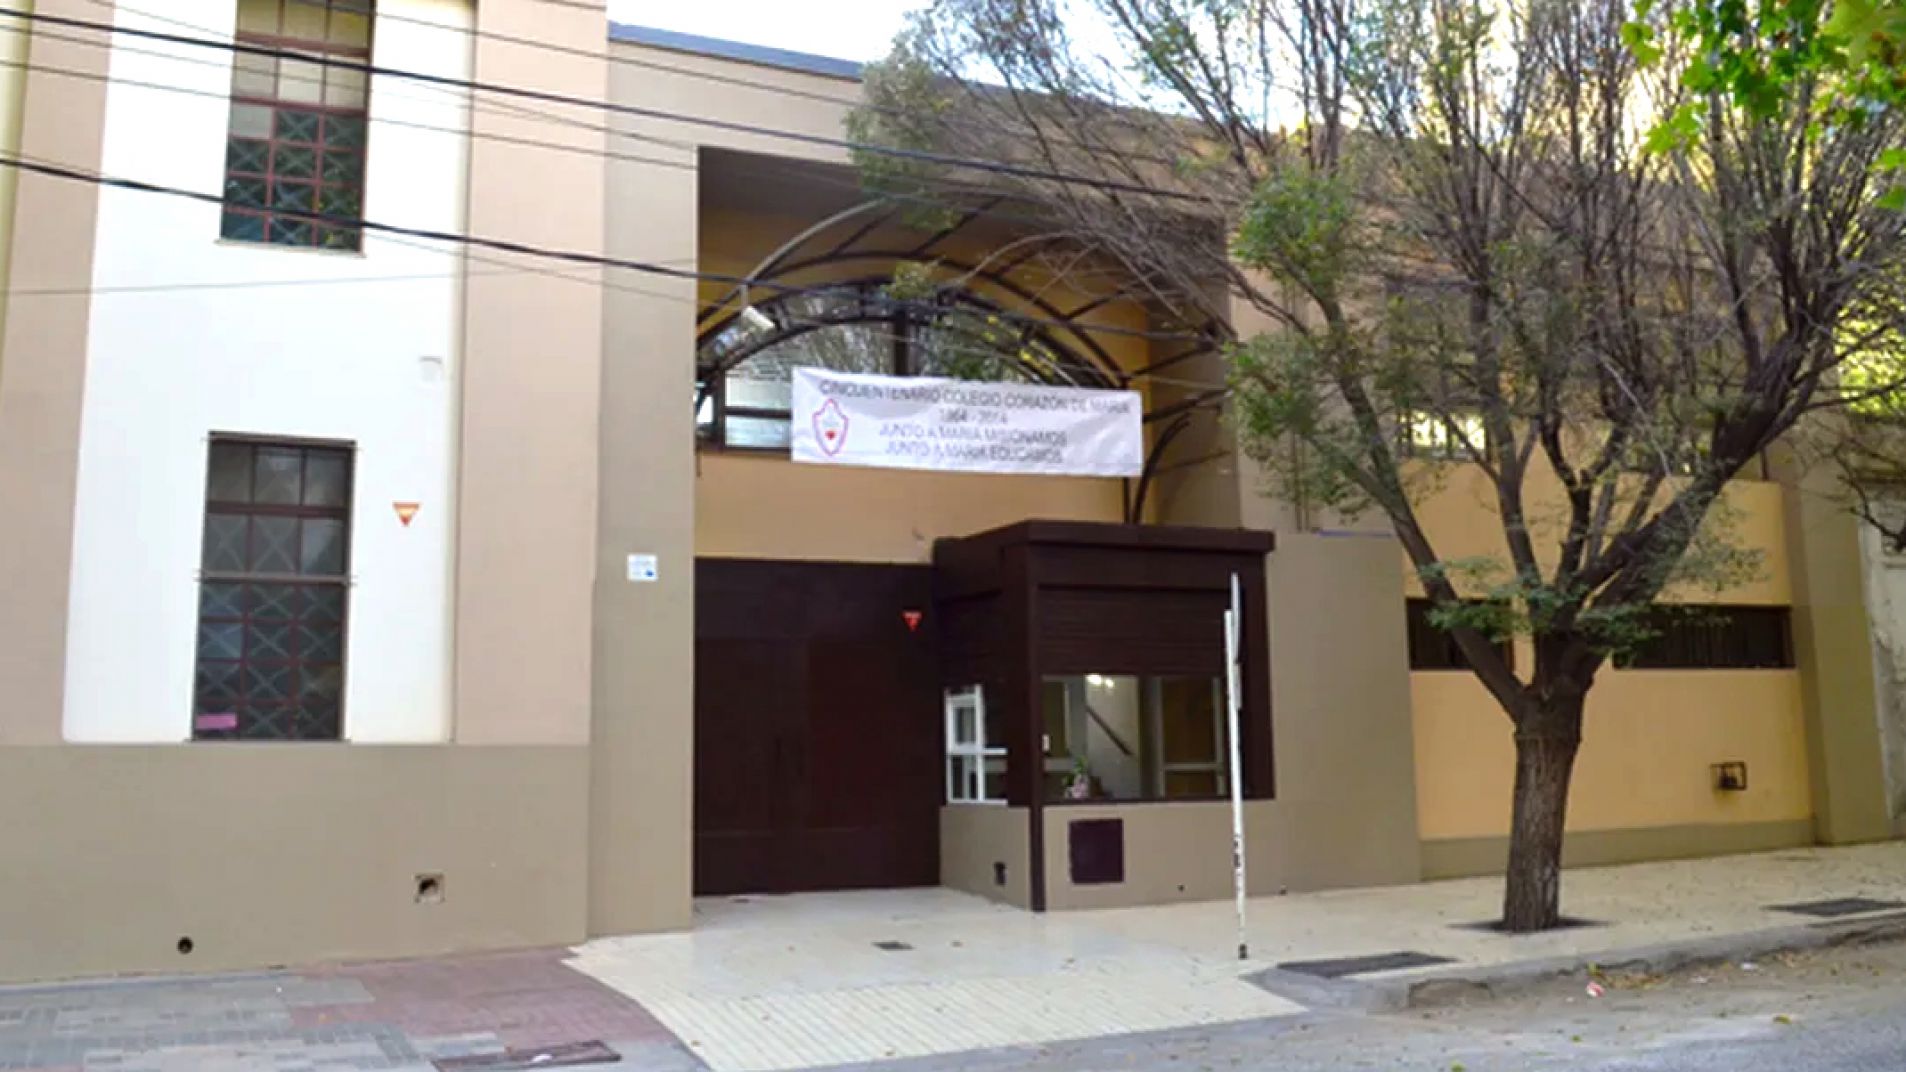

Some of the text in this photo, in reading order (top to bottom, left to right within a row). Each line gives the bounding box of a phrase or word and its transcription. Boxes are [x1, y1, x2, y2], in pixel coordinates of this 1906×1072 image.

[943, 388, 1000, 407] COLEGIO
[879, 424, 924, 438] JUNTO
[885, 440, 929, 456] JUNTO
